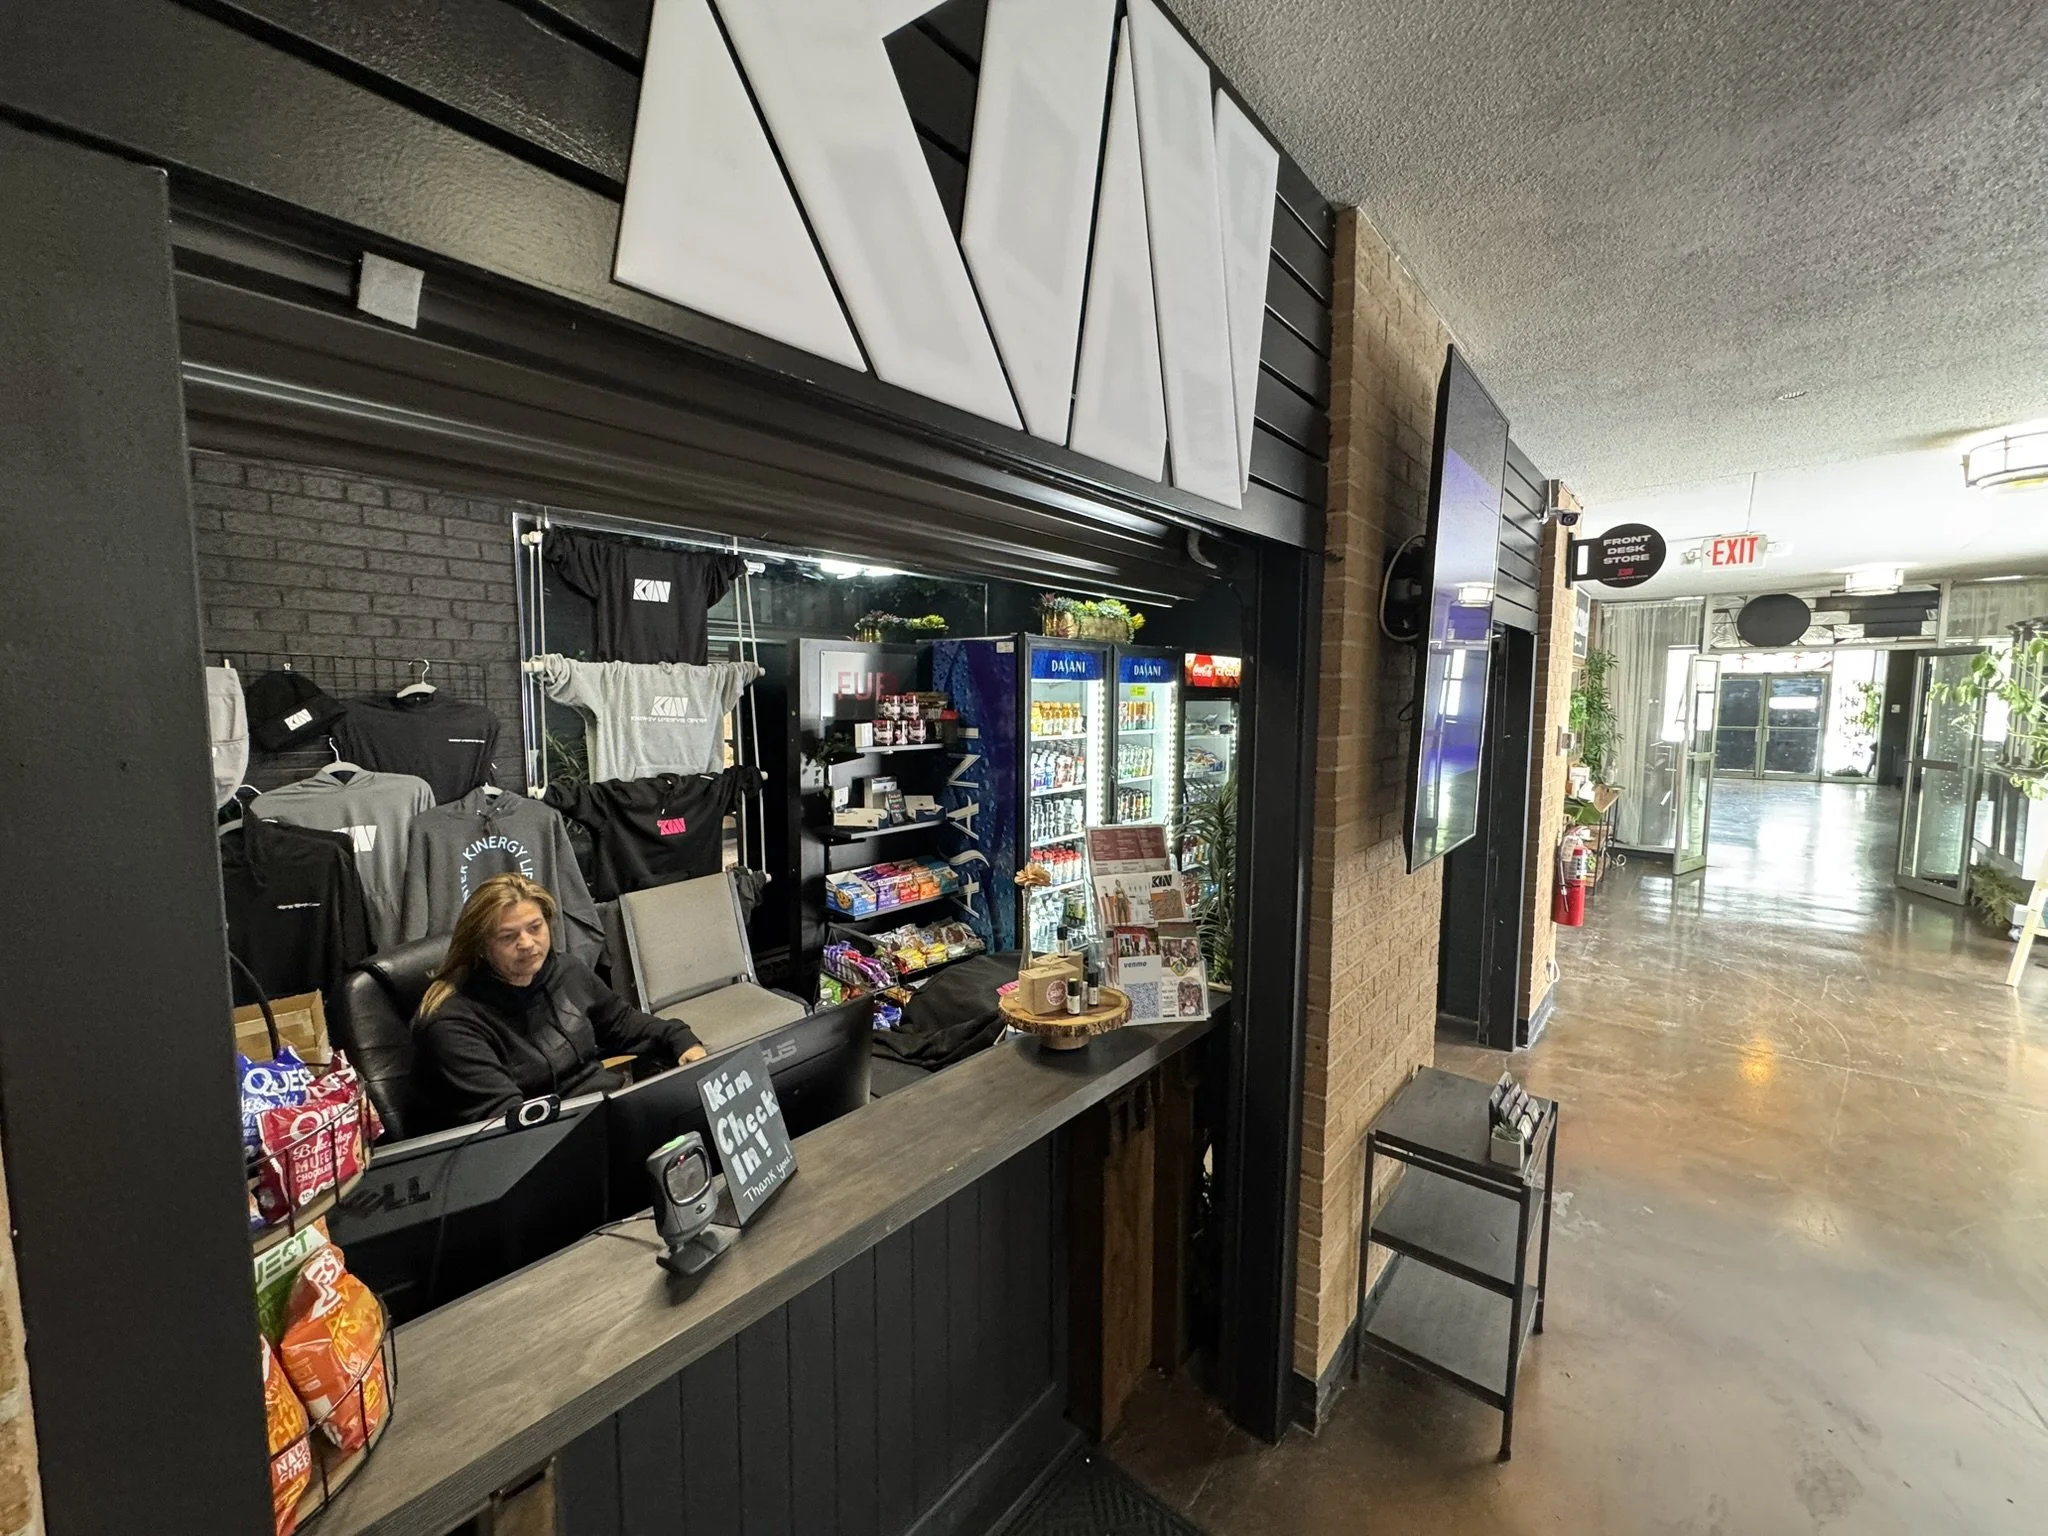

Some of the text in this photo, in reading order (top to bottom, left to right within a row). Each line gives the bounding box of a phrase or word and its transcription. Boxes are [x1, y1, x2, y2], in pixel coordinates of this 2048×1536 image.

[1603, 534, 1652, 547] FRONT
[1607, 545, 1646, 556] DESK
[1712, 536, 1759, 566] EXIT
[1603, 553, 1651, 565] STORE
[1051, 659, 1086, 674] DASANI
[1133, 664, 1161, 676] DASANI
[462, 835, 528, 862] KINERGY
[519, 858, 535, 881] LIF
[1123, 961, 1147, 969] venmo
[703, 1070, 753, 1112] Kin
[717, 1090, 780, 1155] Check
[731, 1128, 773, 1186] In!
[743, 1143, 793, 1202] Thank you!
